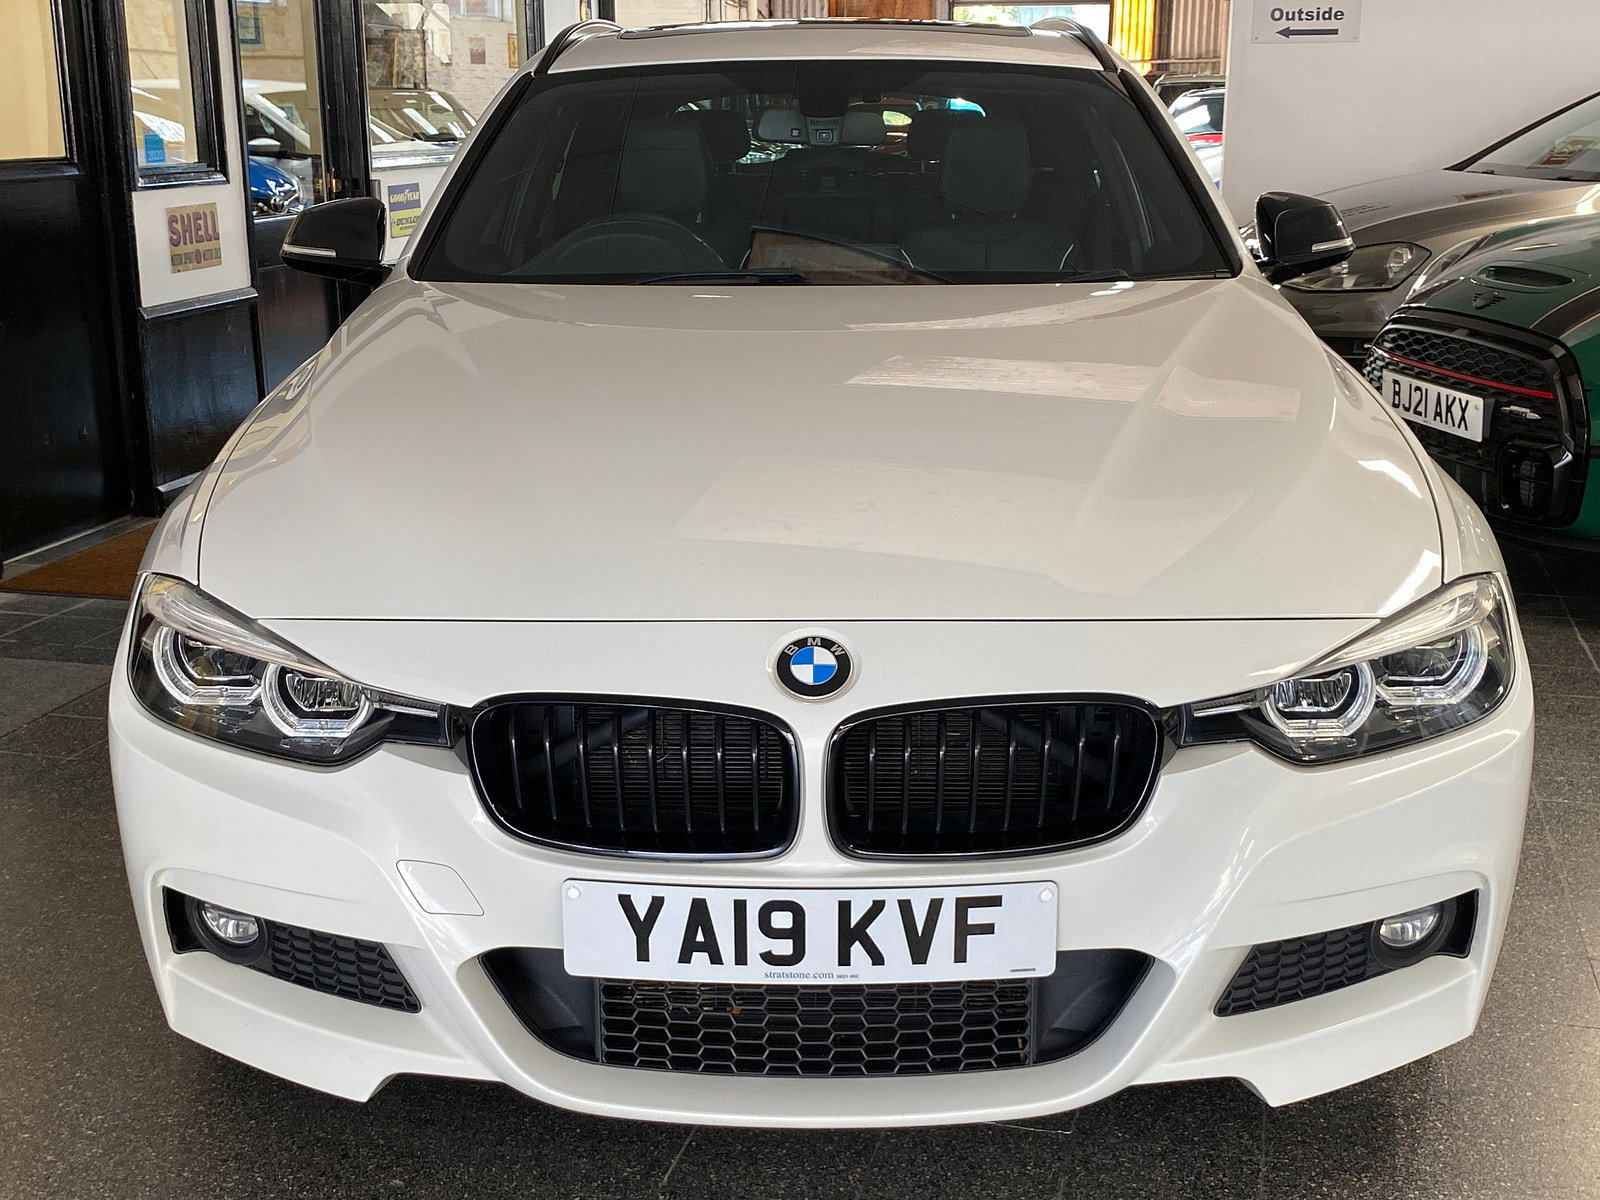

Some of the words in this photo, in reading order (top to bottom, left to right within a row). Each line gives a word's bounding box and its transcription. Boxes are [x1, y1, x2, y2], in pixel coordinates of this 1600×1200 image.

[1270, 7, 1345, 22] Outside
[147, 150, 164, 161] 2020
[168, 210, 220, 247] SHELL
[1391, 378, 1429, 419] BJ21
[1433, 391, 1470, 432] AKX
[784, 637, 846, 656] BMW
[618, 894, 806, 967] YA19
[838, 894, 1003, 967] KVF
[764, 971, 834, 979] stratstone.com
